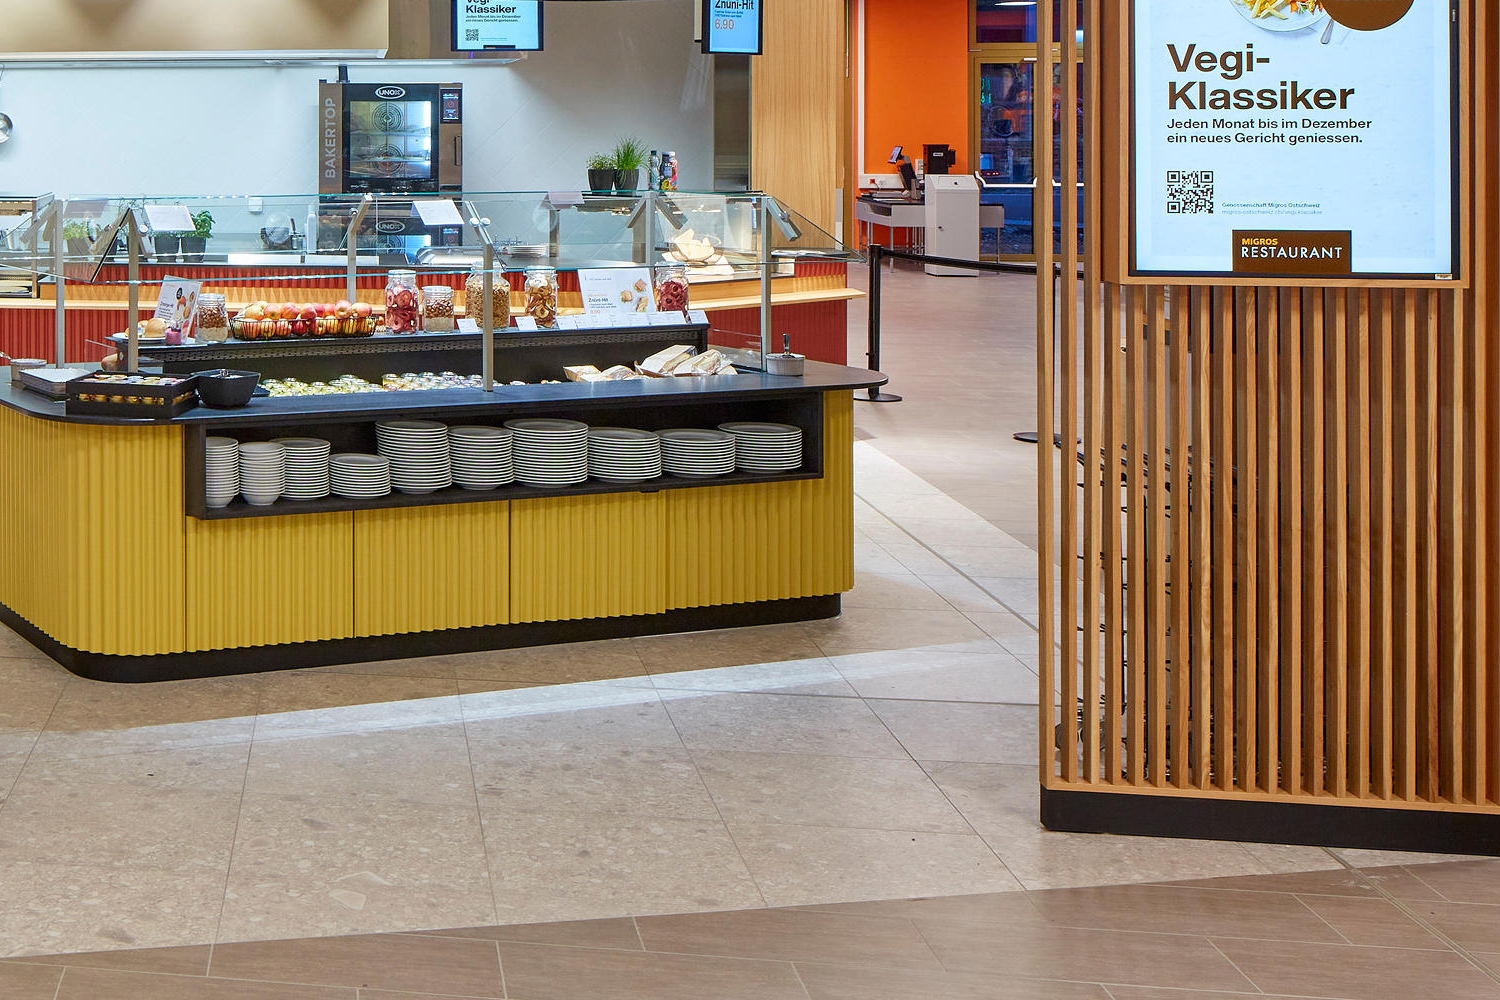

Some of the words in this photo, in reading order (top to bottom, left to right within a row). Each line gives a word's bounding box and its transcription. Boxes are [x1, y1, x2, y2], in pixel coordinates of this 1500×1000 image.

[466, 5, 517, 14] Klassiker
[715, 19, 734, 30] 6.90
[1167, 43, 1270, 80] Vegi-
[1168, 81, 1355, 110] Klassiker
[1167, 119, 1208, 129] Jeden
[1212, 119, 1255, 129] Monat
[1258, 119, 1278, 129] bis
[1281, 119, 1298, 129] im
[1301, 118, 1373, 129] Dezember
[324, 97, 336, 178] BAKERTOP
[1167, 133, 1187, 143] ein
[1190, 134, 1232, 143] neues
[1235, 133, 1286, 143] Gericht
[1288, 133, 1363, 145] geniessen.
[1241, 238, 1279, 246] MIGROS
[1241, 246, 1343, 259] RESTAURANT
